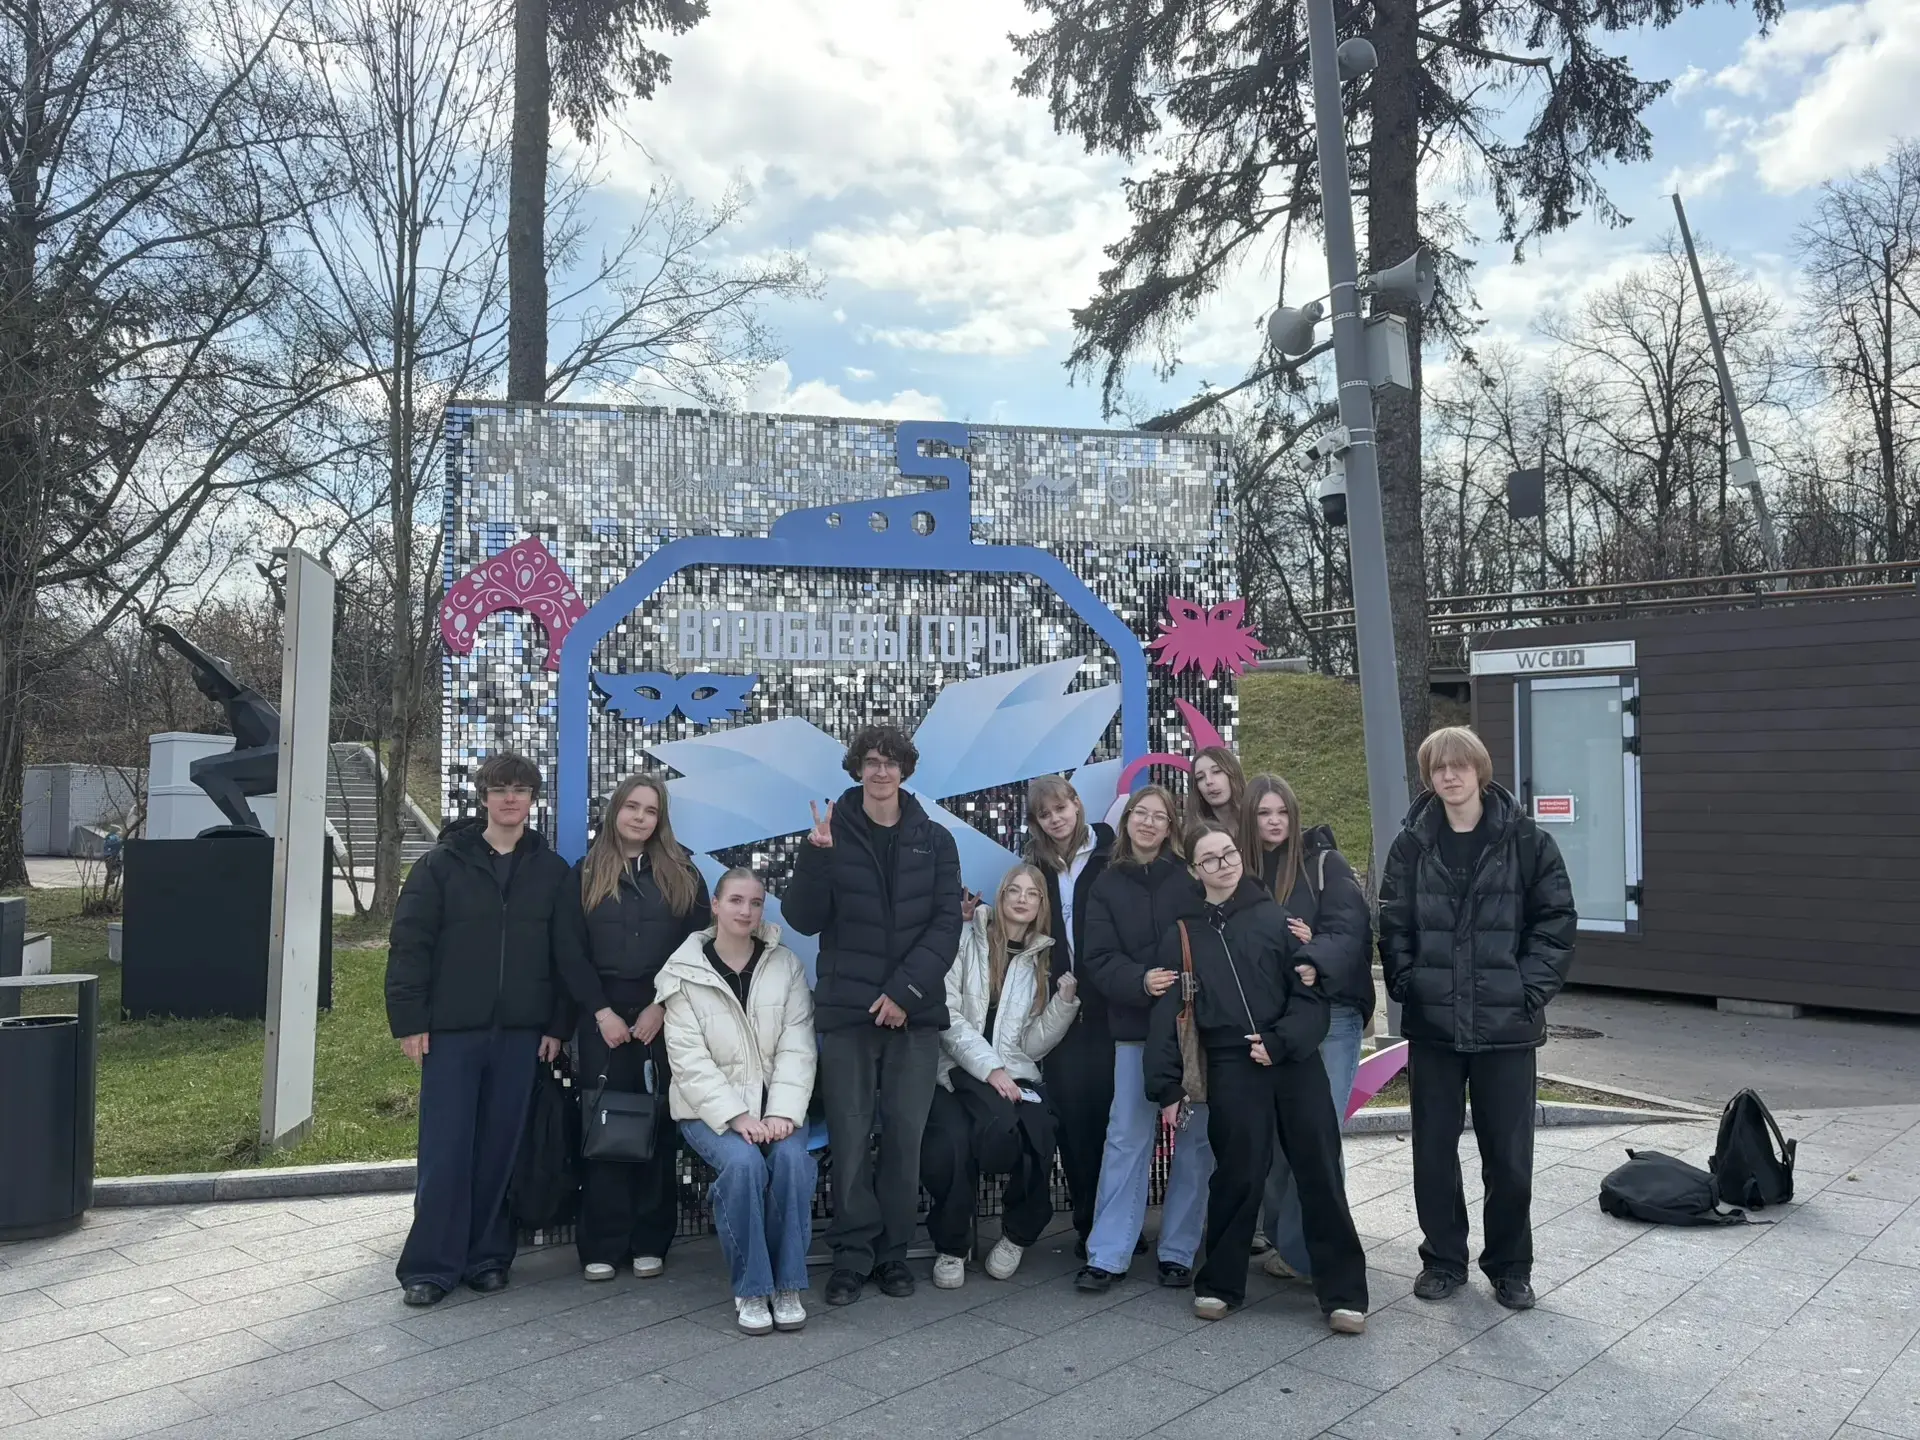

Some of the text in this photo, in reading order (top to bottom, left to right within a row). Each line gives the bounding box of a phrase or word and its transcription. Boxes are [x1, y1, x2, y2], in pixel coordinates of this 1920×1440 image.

[679, 609, 1018, 664] ВОРОБЬЕВЫ ГОРЫ
[1516, 651, 1550, 669] WC
